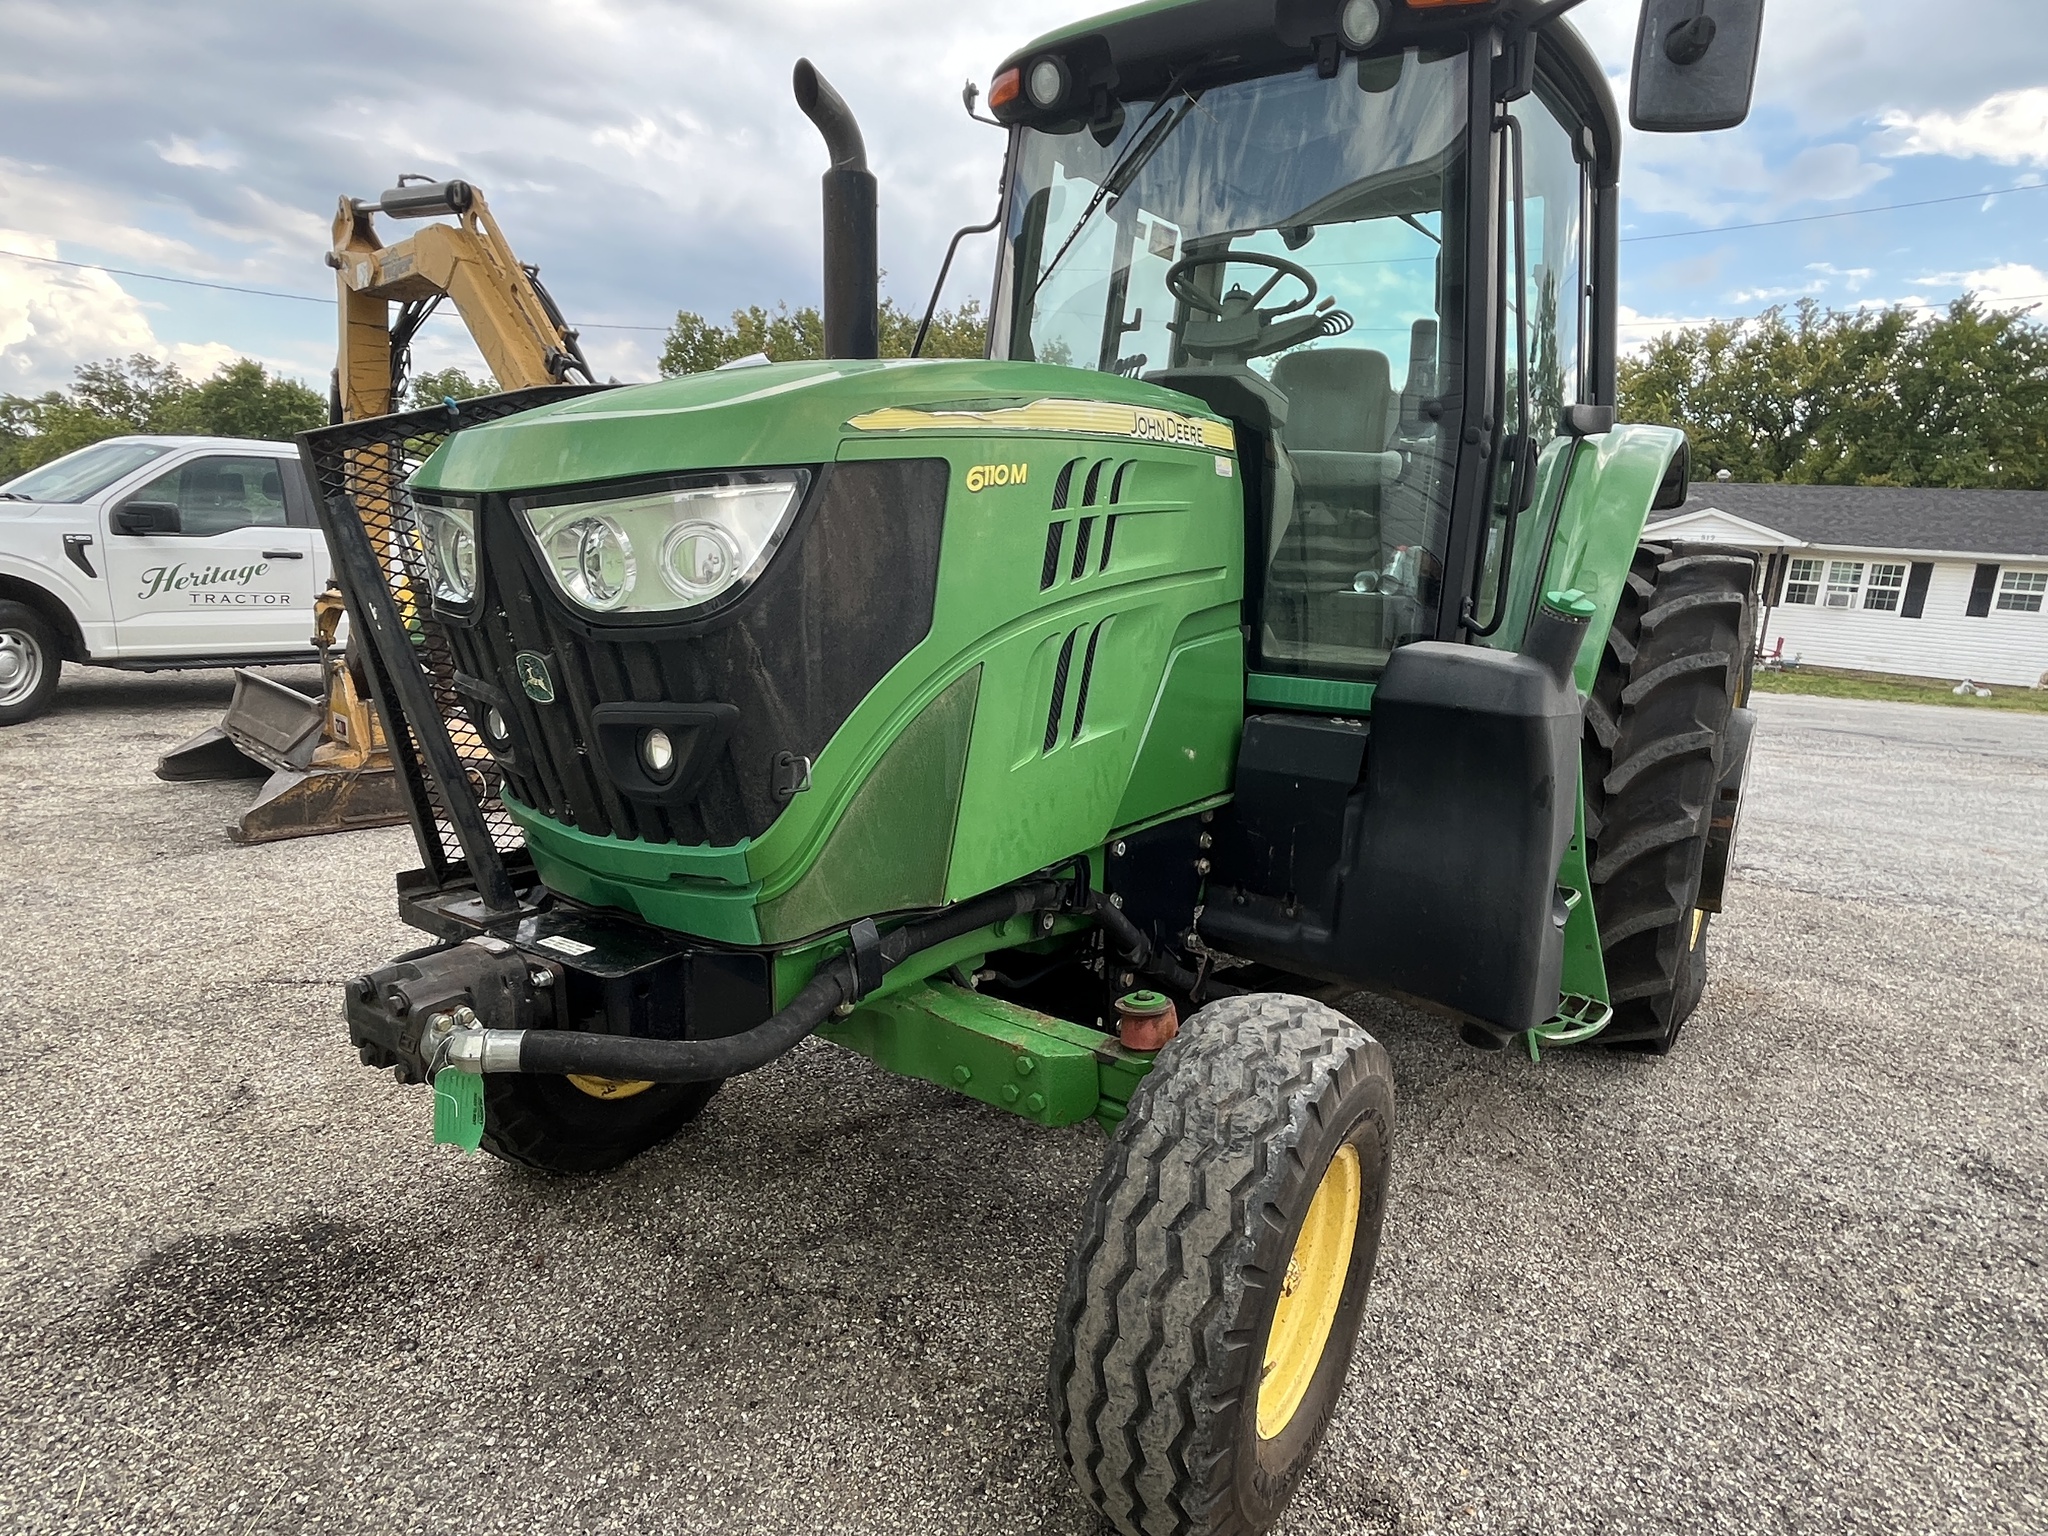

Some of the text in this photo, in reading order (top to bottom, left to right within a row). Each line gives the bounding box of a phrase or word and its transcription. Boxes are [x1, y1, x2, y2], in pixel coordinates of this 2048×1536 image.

[1131, 412, 1203, 444] JOHN DEERE
[966, 463, 1028, 492] 6110M
[138, 562, 270, 600] Heritage
[189, 593, 291, 604] TRACTOR
